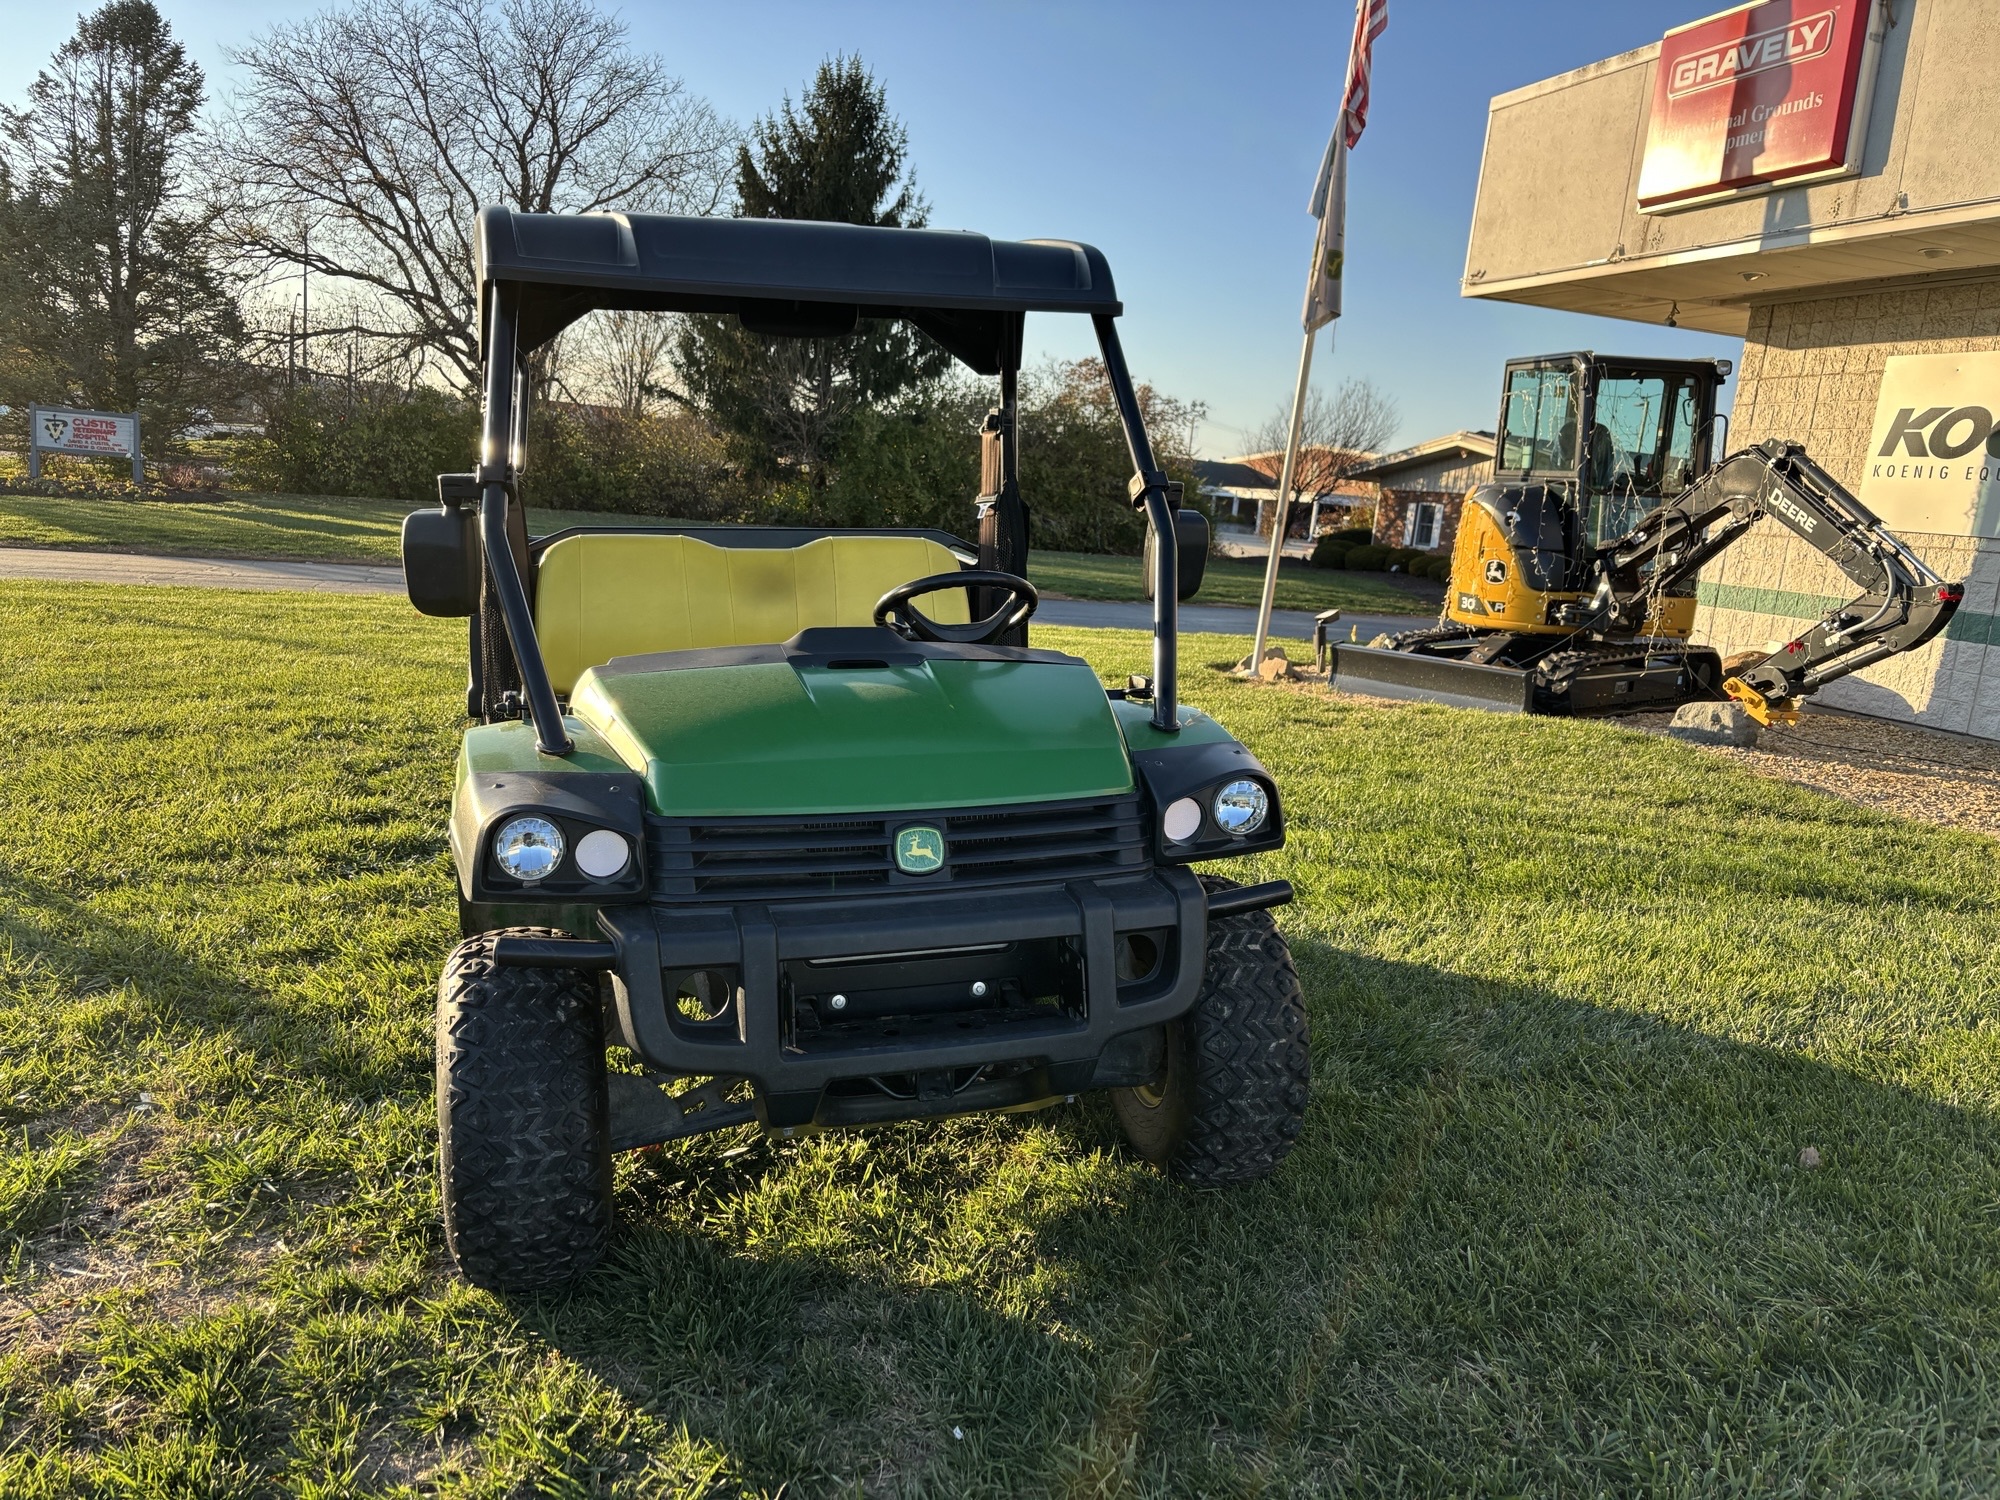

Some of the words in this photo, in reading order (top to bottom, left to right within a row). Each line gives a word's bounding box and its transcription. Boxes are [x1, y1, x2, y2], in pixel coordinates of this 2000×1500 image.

[1673, 19, 1828, 89] GRAVELY
[1751, 91, 1824, 123] Grounds
[72, 418, 117, 430] CUSTIS
[73, 426, 117, 436] VETERINARY
[1877, 405, 2000, 460] KO
[73, 432, 111, 442] HOSPITAL
[1872, 463, 1949, 480] KOENIG
[1767, 487, 1818, 534] DEERE
[1461, 596, 1476, 610] 30
